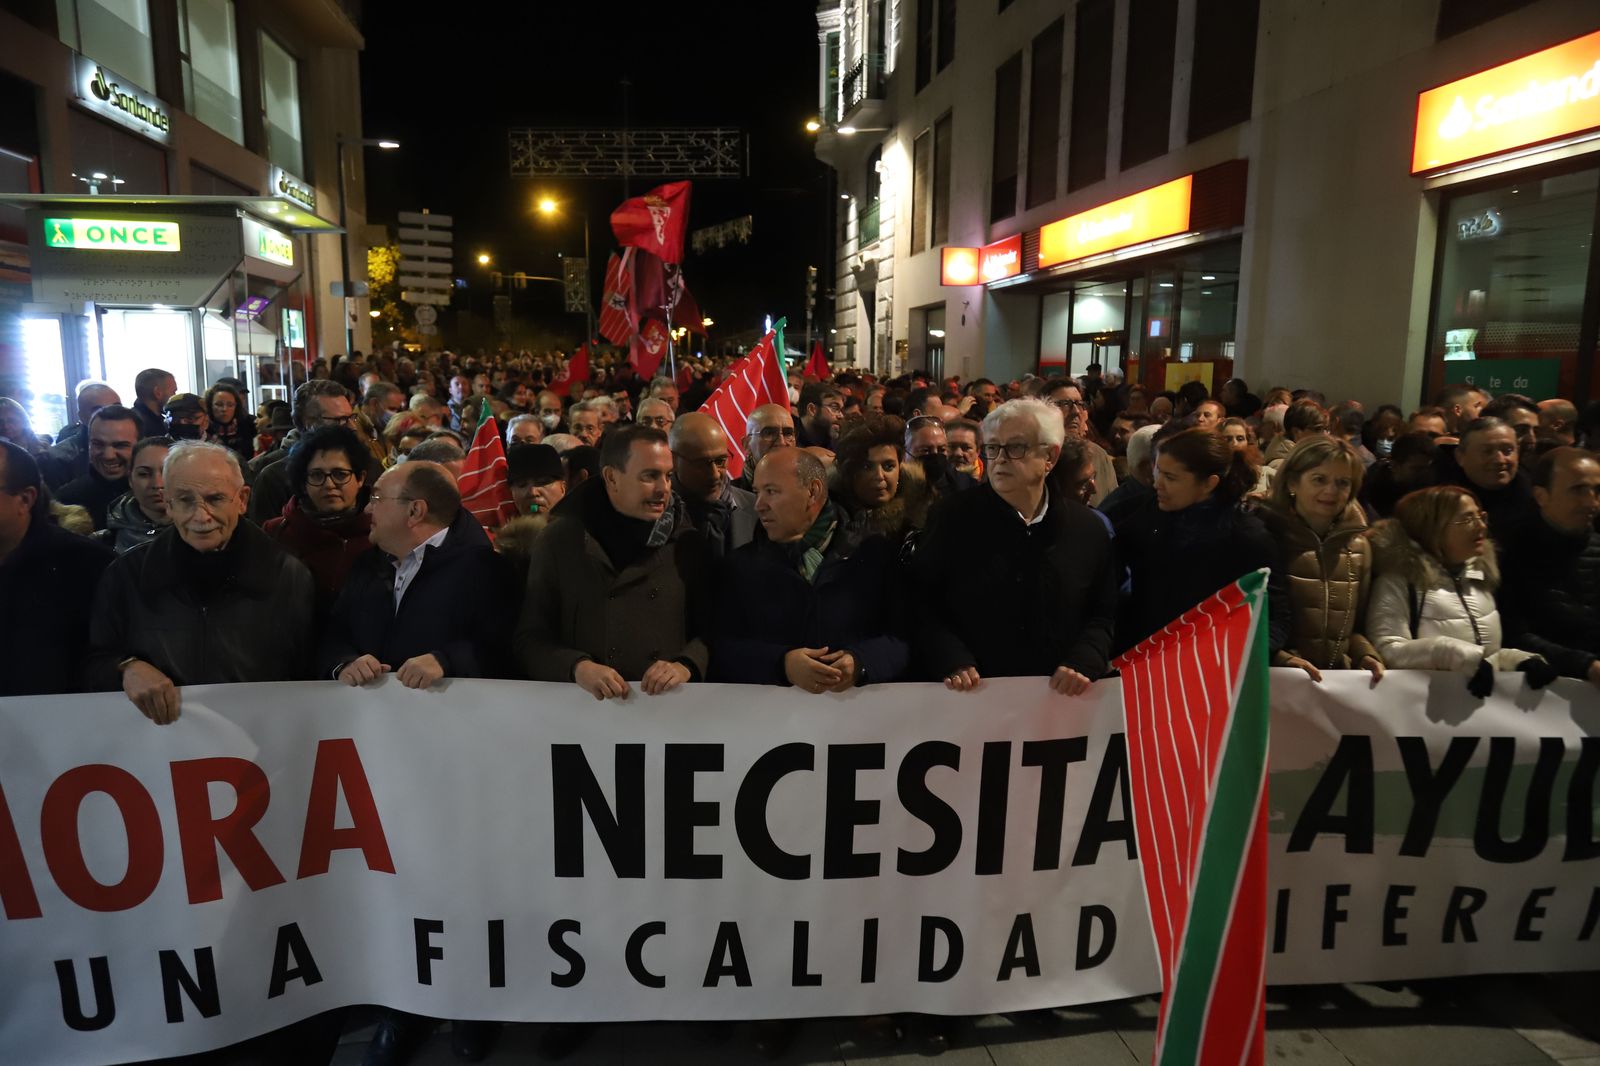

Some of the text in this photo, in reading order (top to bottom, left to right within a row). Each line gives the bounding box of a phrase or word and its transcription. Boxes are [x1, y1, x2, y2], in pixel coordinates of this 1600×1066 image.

[109, 82, 171, 135] Santande
[86, 226, 168, 245] ONCE
[1489, 376, 1502, 389] te
[551, 733, 1138, 880] NECESITA
[54, 884, 1600, 1031] UNA FISCALIDAD IFERE
